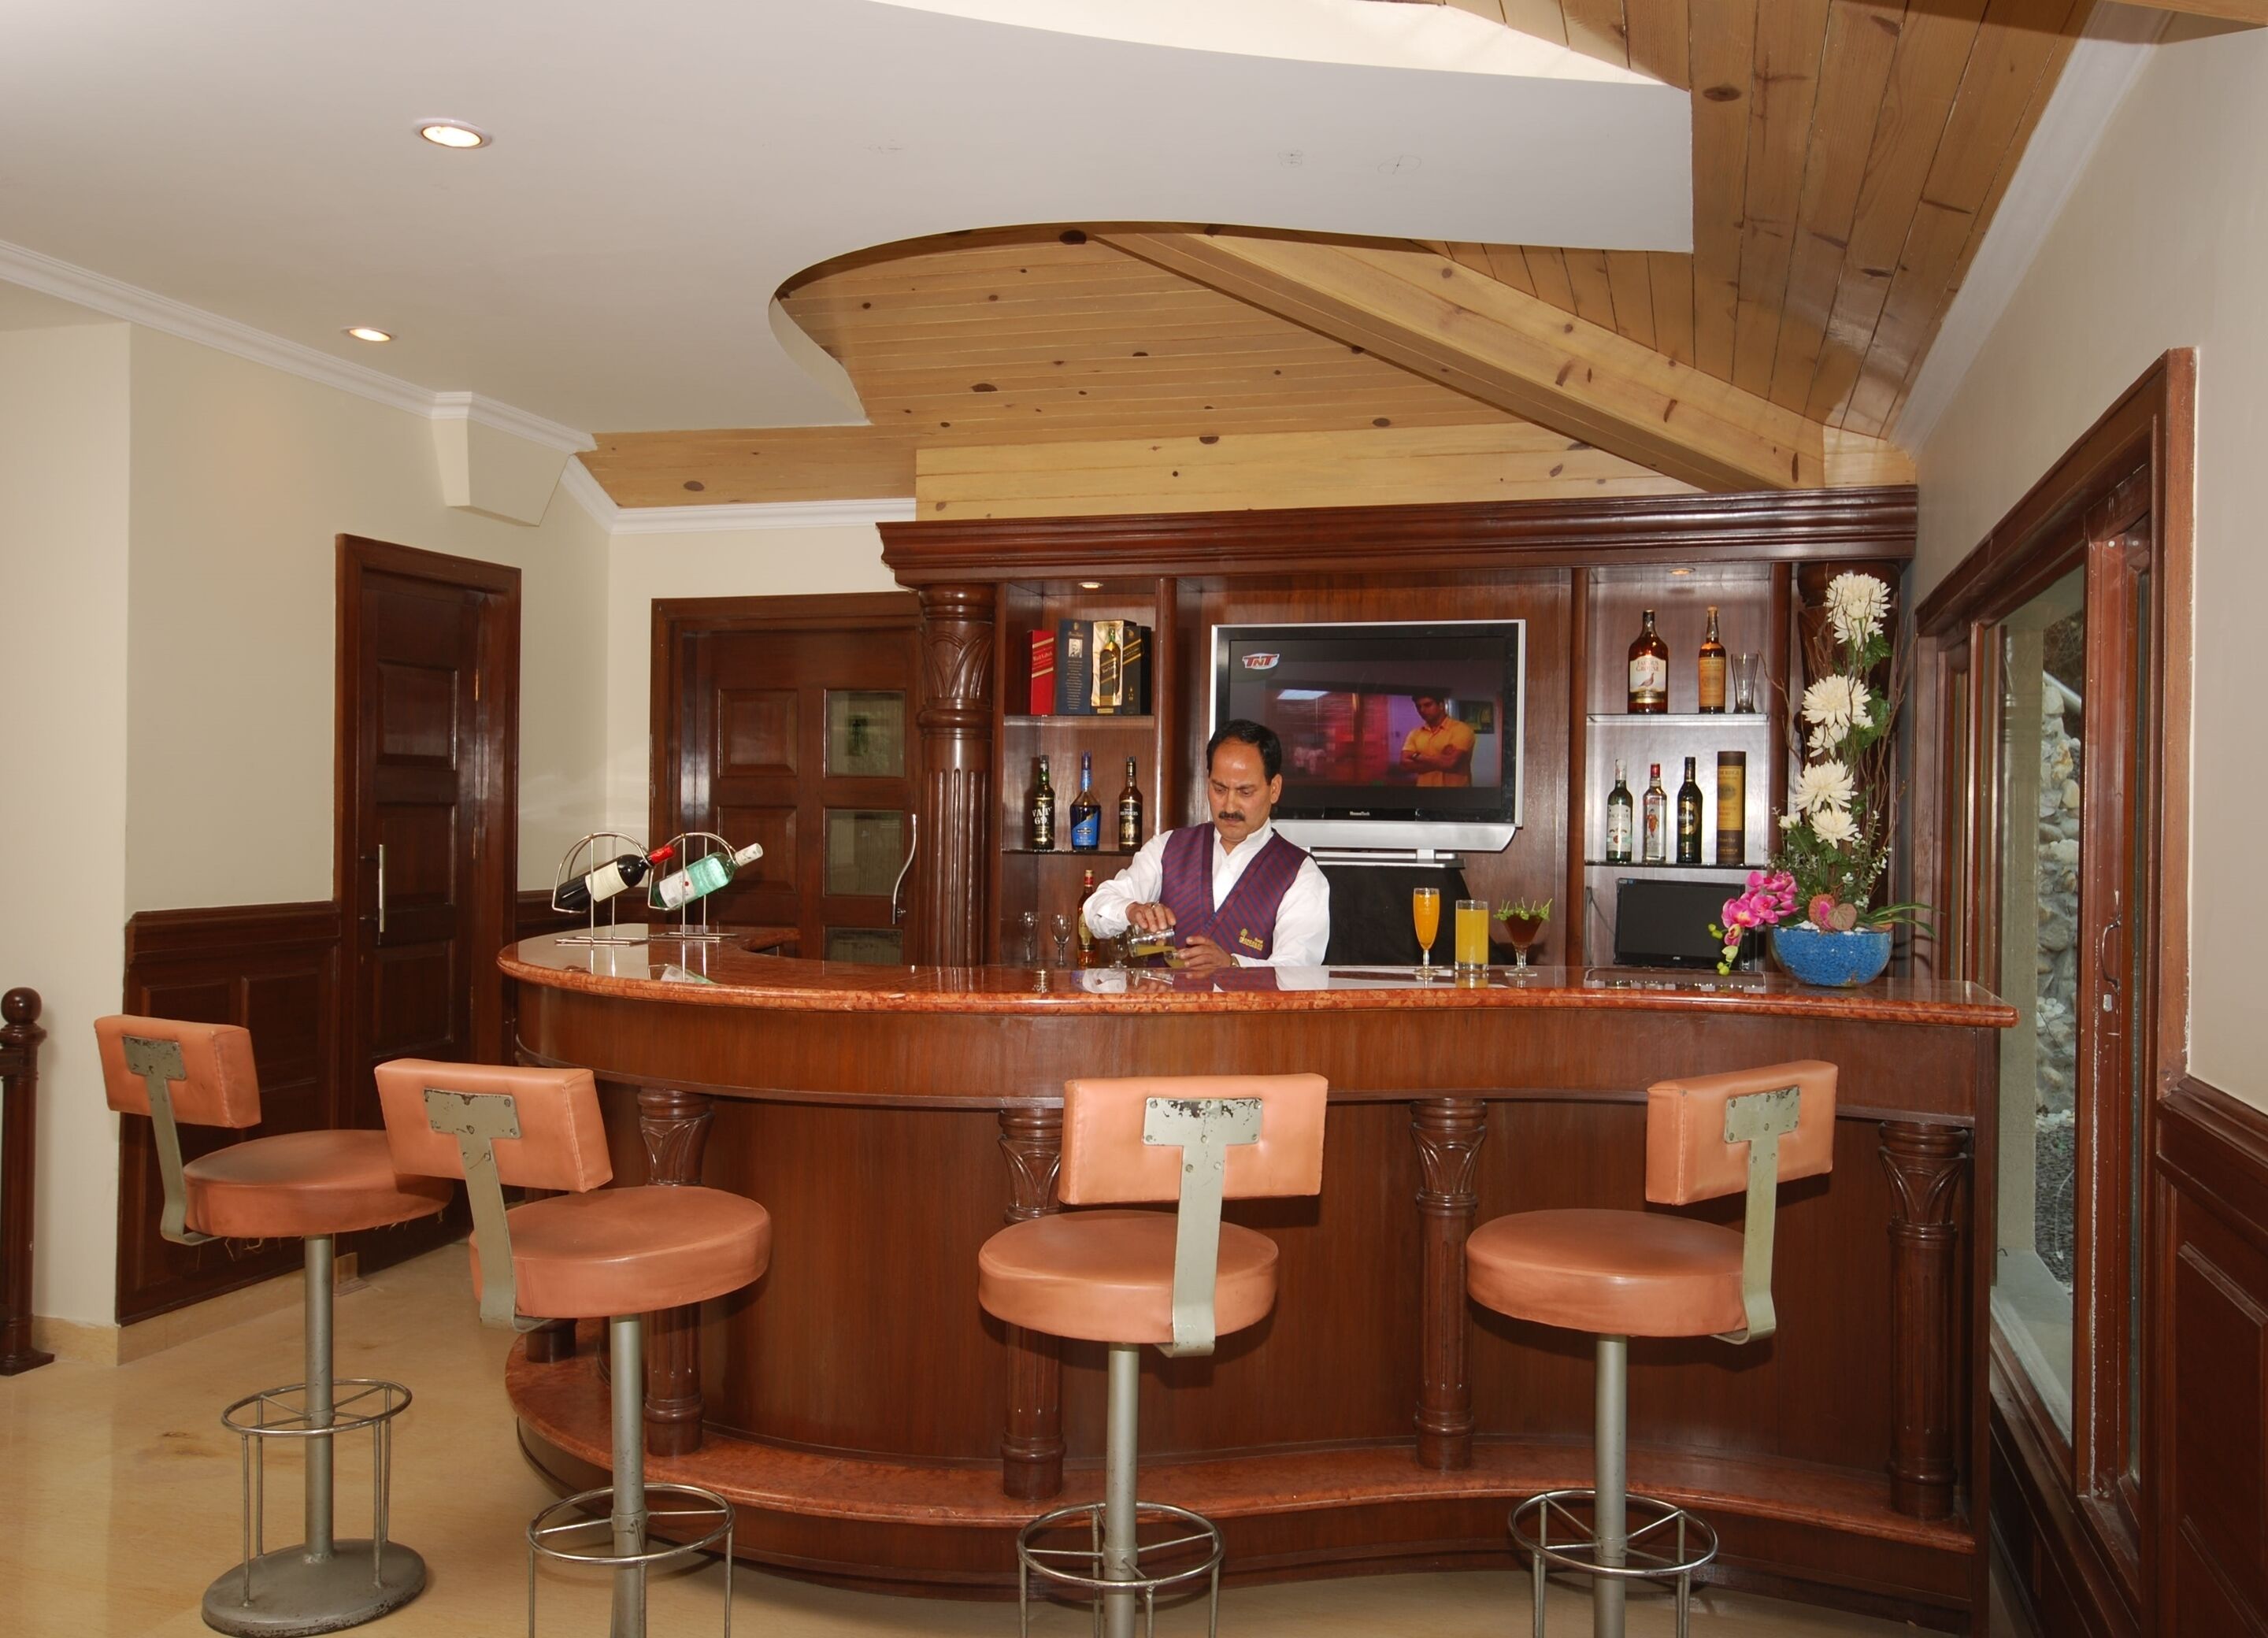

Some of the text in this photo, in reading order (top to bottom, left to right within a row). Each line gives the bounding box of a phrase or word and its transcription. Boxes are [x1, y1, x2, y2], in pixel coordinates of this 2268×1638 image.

[1242, 654, 1279, 669] TNT
[1032, 806, 1052, 817] VAT
[1034, 817, 1047, 825] 69
